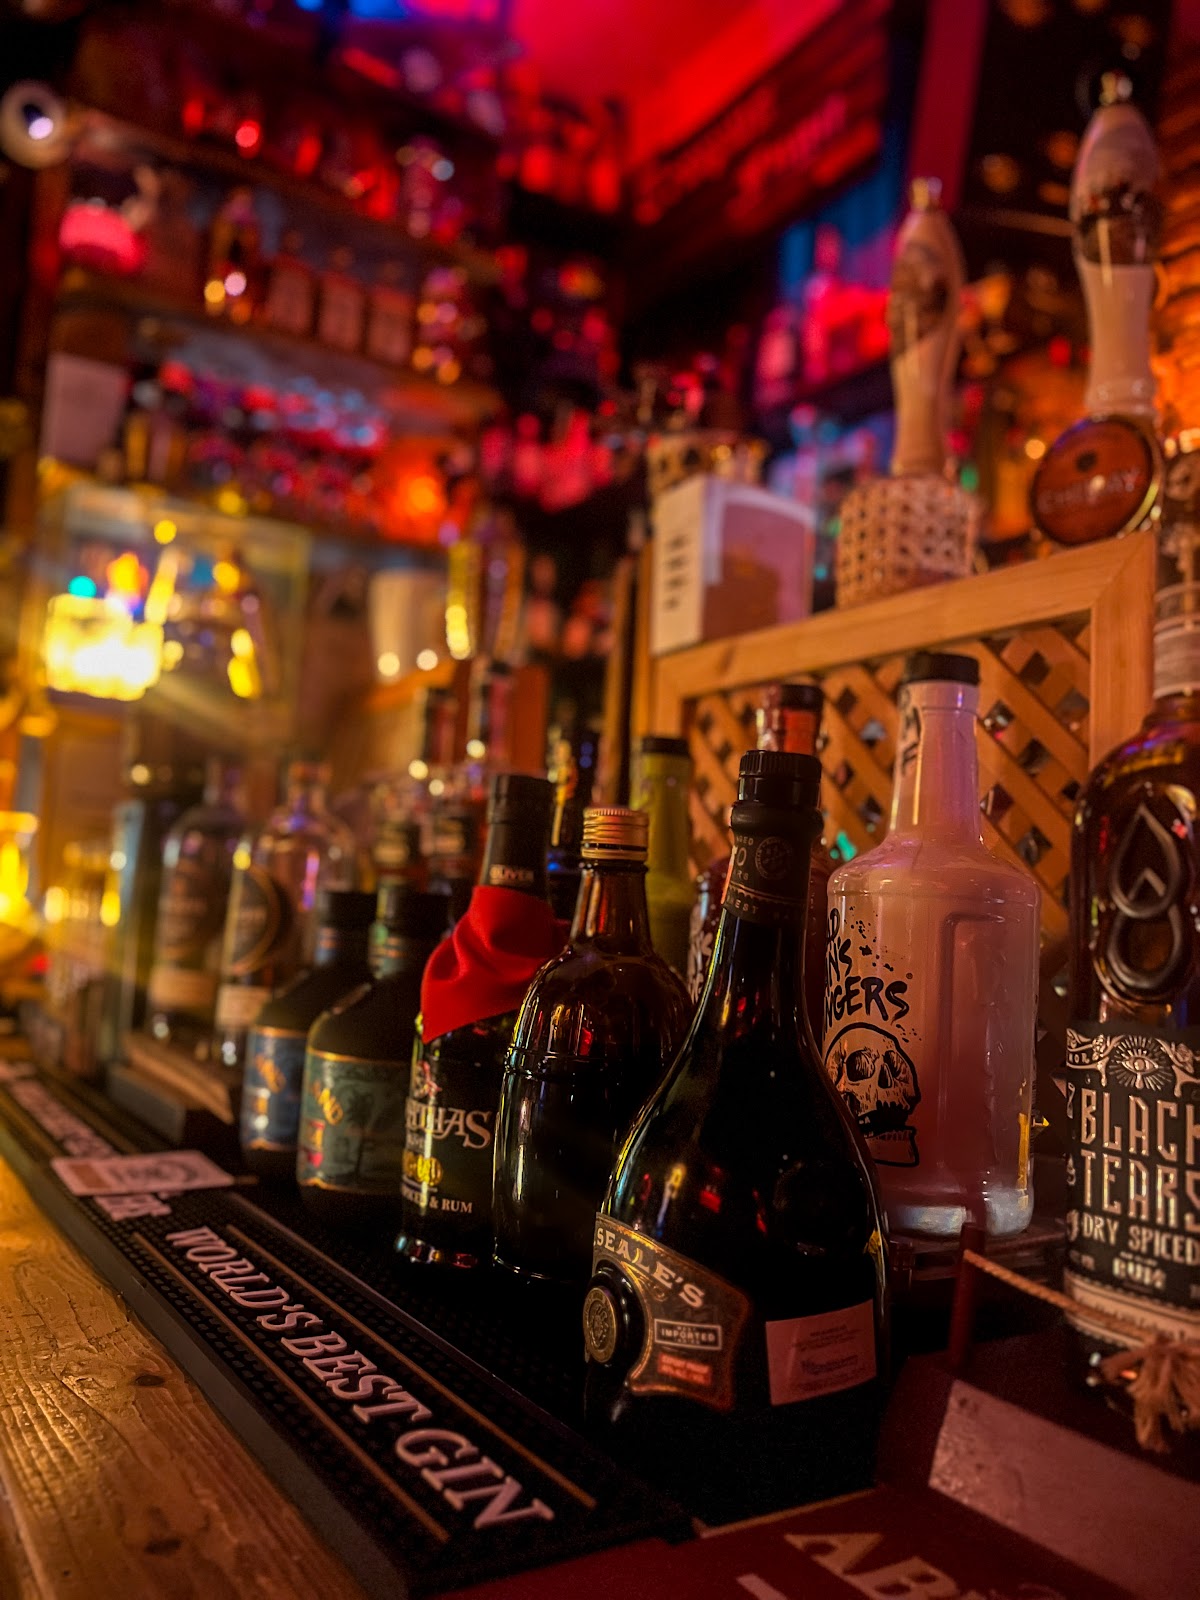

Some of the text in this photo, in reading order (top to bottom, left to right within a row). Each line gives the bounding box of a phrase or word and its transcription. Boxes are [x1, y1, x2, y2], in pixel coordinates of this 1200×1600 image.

[441, 1199, 473, 1214] RUM
[1083, 1212, 1119, 1246] DRY
[661, 1328, 716, 1343] IMPORTED
[166, 1225, 555, 1530] WORLD'S BEST GIN
